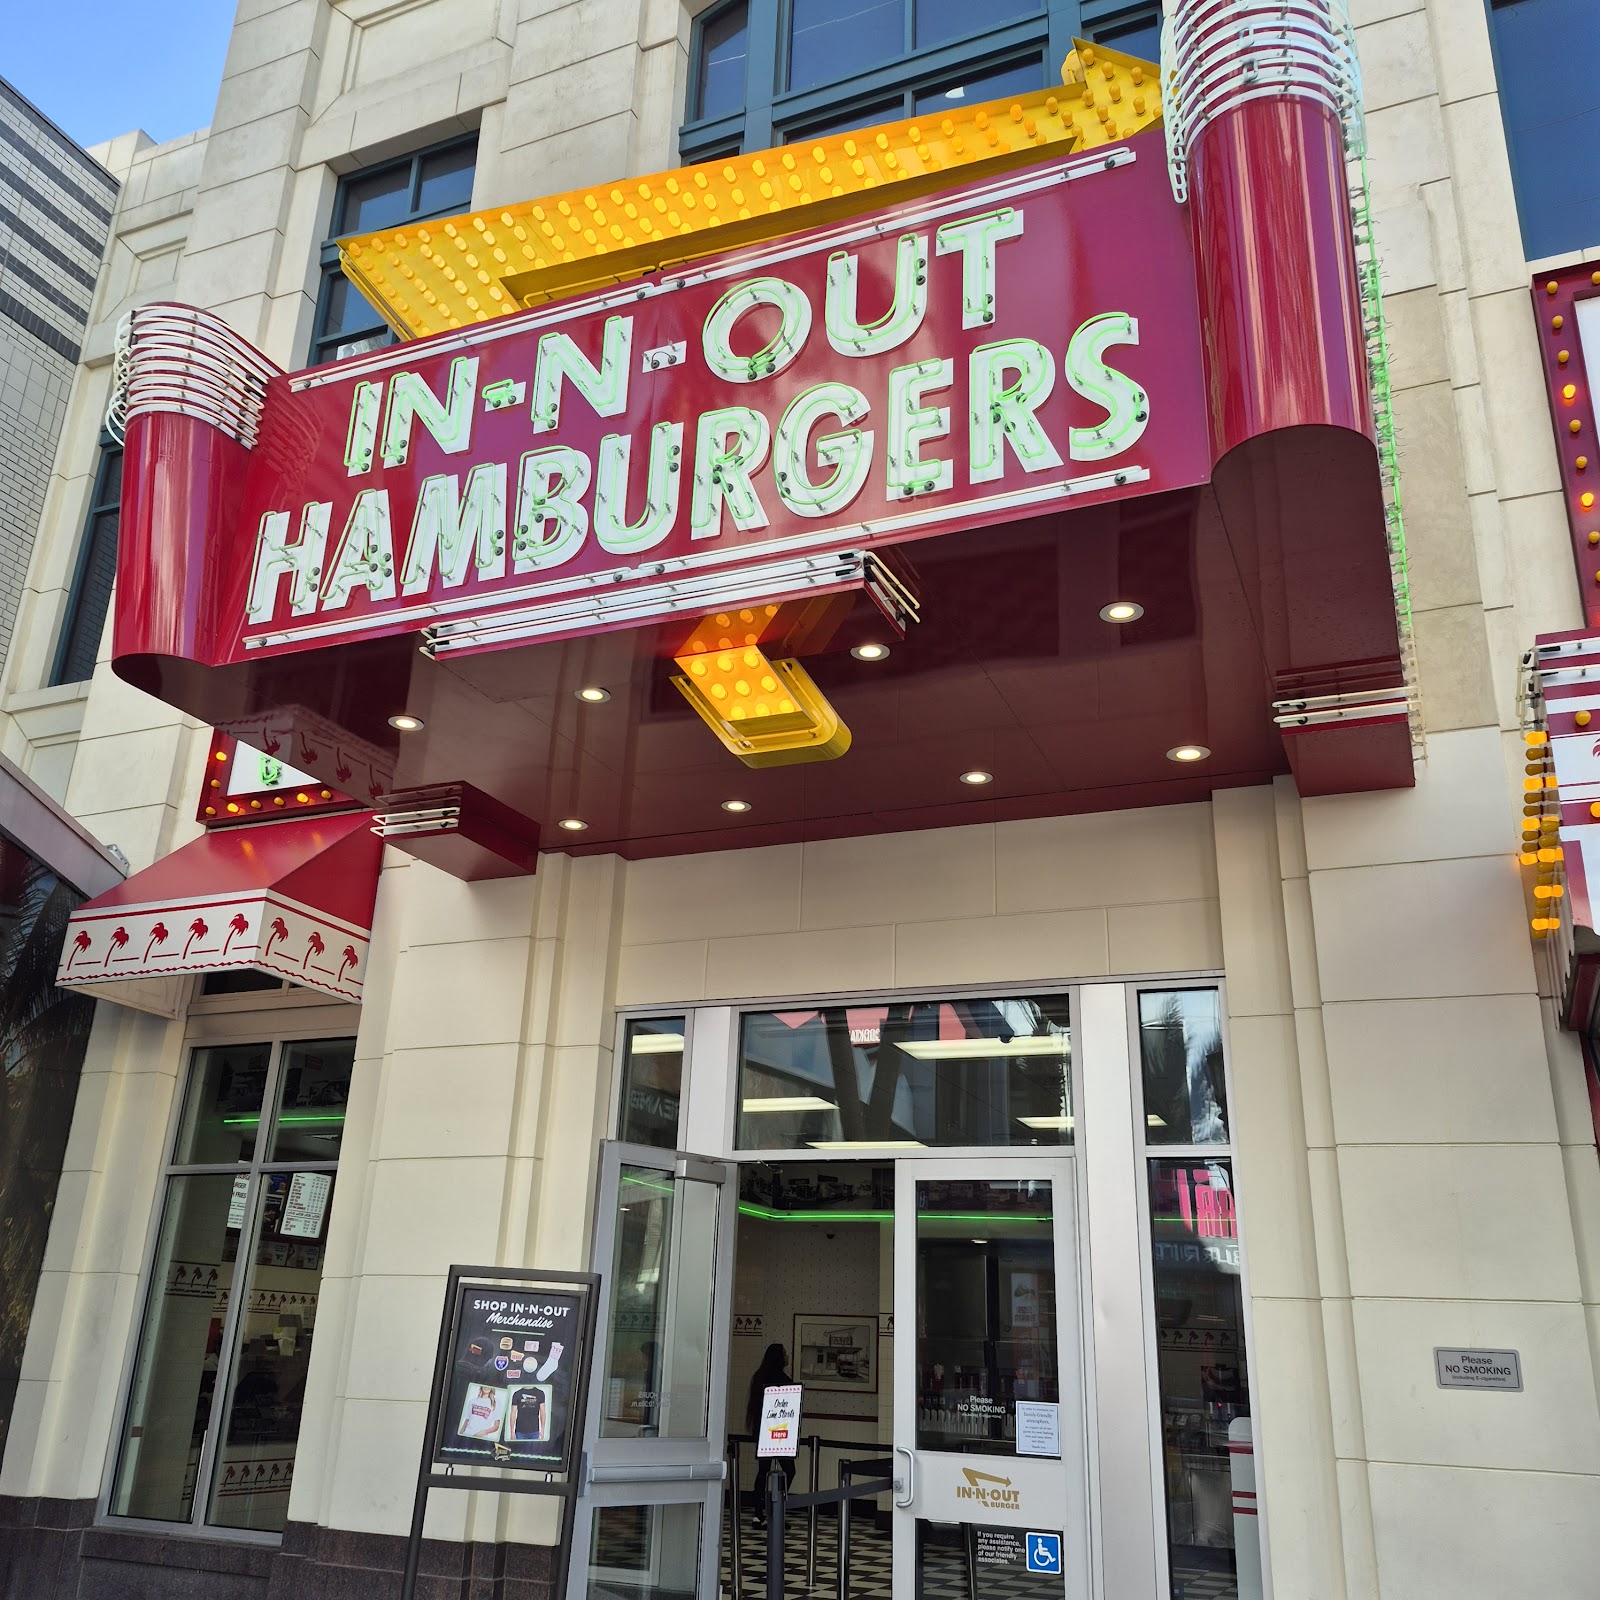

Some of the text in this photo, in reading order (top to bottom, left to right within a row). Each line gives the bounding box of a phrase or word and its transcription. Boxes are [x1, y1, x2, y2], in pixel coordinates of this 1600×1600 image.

[345, 207, 1024, 477] IN-N-OUT
[246, 311, 1151, 626] HAMBURGERS
[473, 1299, 570, 1317] SHOP IN-N-OUT
[486, 1312, 554, 1329] Merchandise
[1461, 1355, 1493, 1365] Please
[1445, 1365, 1511, 1375] NO SMOKING
[774, 1399, 788, 1408] Order
[970, 1395, 993, 1404] Please
[767, 1409, 794, 1419] Line Starts
[957, 1404, 1006, 1414] NO SMOKING
[990, 1501, 1020, 1510] BURGER
[989, 1539, 1021, 1547] assistance,
[996, 1551, 1017, 1560] friendly
